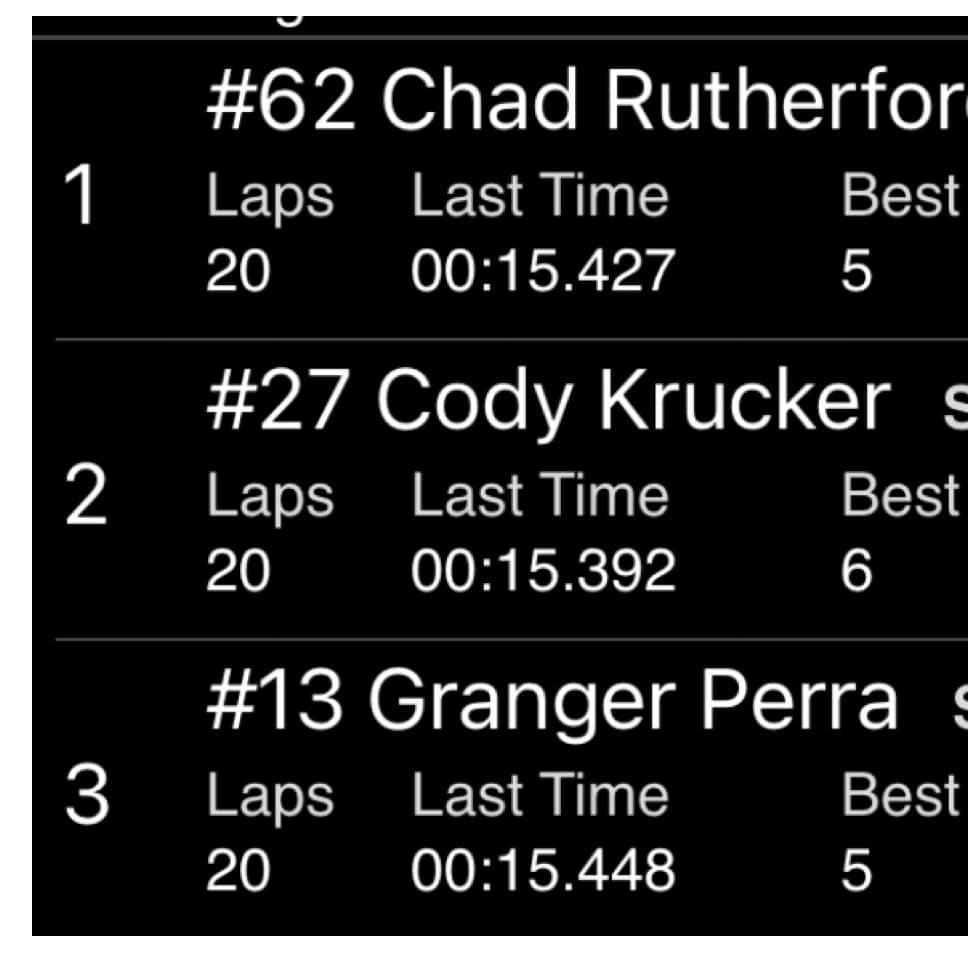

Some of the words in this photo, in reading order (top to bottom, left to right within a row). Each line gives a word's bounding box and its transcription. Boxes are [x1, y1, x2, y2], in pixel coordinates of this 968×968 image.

[207, 67, 355, 131] #62
[383, 66, 576, 131] Chad
[65, 163, 90, 224] 1
[209, 172, 334, 229] Laps
[415, 172, 523, 217] Last
[539, 172, 668, 217] Time
[844, 172, 960, 217] Best
[207, 248, 270, 292] 20
[412, 248, 676, 292] 00:15.427
[842, 248, 872, 292] 5
[206, 367, 350, 431] #27
[378, 366, 574, 445] Cody
[602, 366, 891, 430] Krucker
[66, 462, 107, 524] 2
[209, 472, 334, 529] Laps
[415, 472, 523, 517] Last
[539, 472, 668, 517] Time
[844, 472, 960, 517] Best
[207, 548, 270, 592] 20
[412, 548, 676, 592] 00:15.392
[842, 548, 872, 592] 6
[207, 667, 342, 731] #13
[370, 667, 676, 745] Granger
[704, 668, 896, 730] Perra
[66, 762, 109, 825] 3
[209, 772, 334, 829] Laps
[415, 772, 523, 817] Last
[539, 772, 668, 817] Time
[844, 772, 960, 817] Best
[207, 848, 270, 892] 20
[412, 848, 676, 892] 00:15.448
[842, 848, 872, 892] 5
